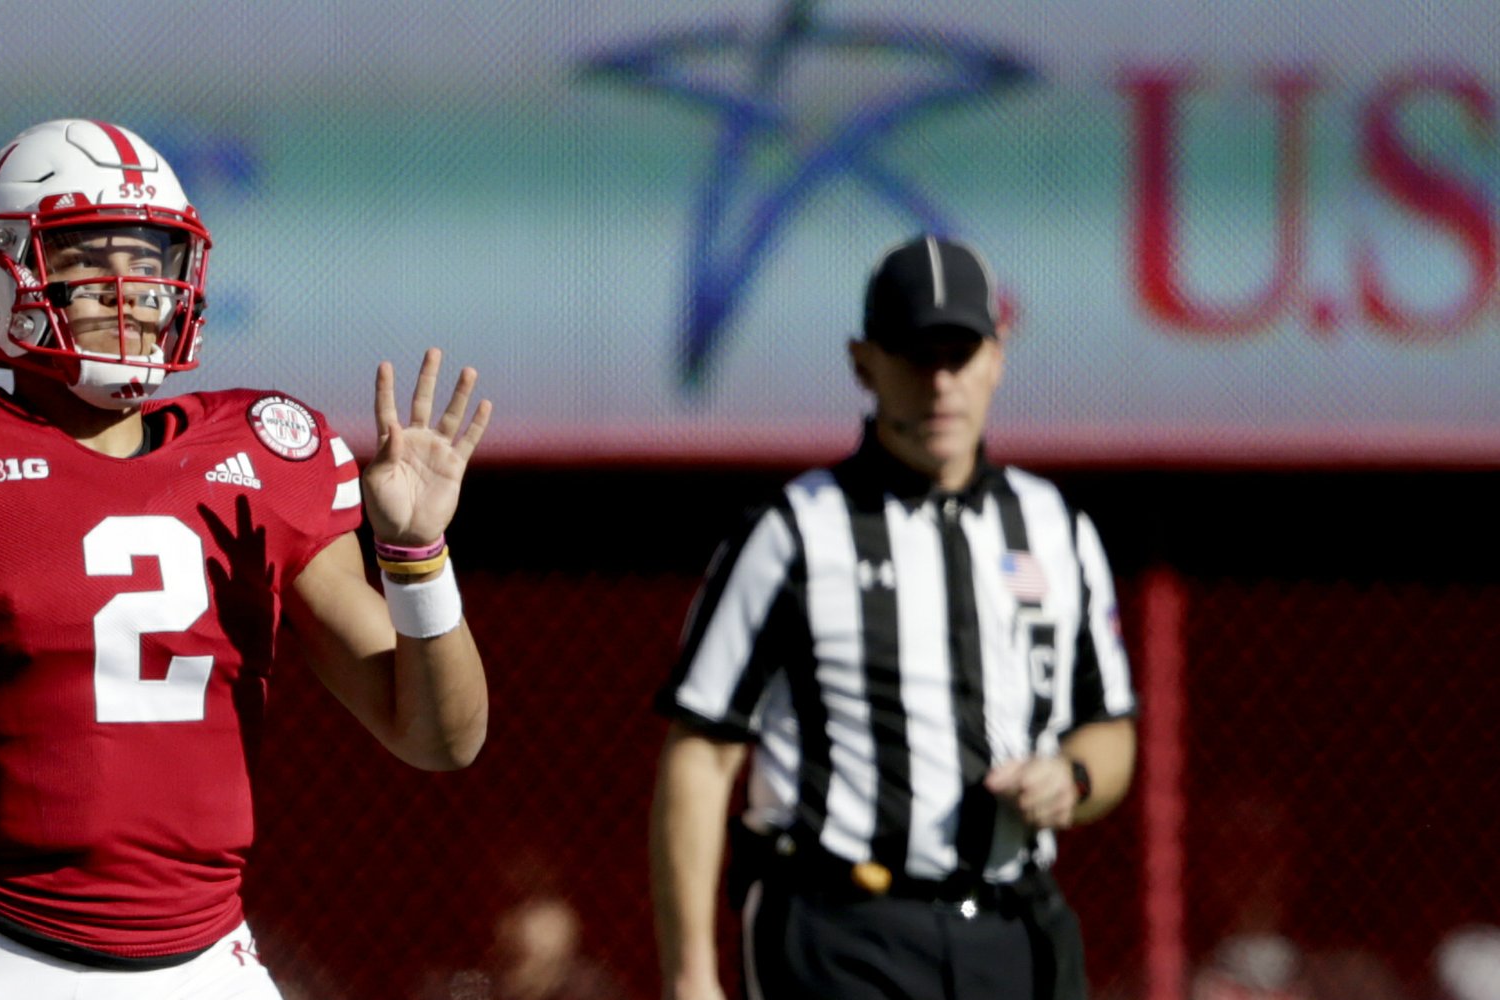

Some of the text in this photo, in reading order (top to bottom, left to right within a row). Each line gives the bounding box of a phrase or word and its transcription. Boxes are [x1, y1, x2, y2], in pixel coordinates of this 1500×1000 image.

[119, 183, 157, 199] 559
[205, 469, 261, 489] adidas
[83, 515, 213, 722] 2
